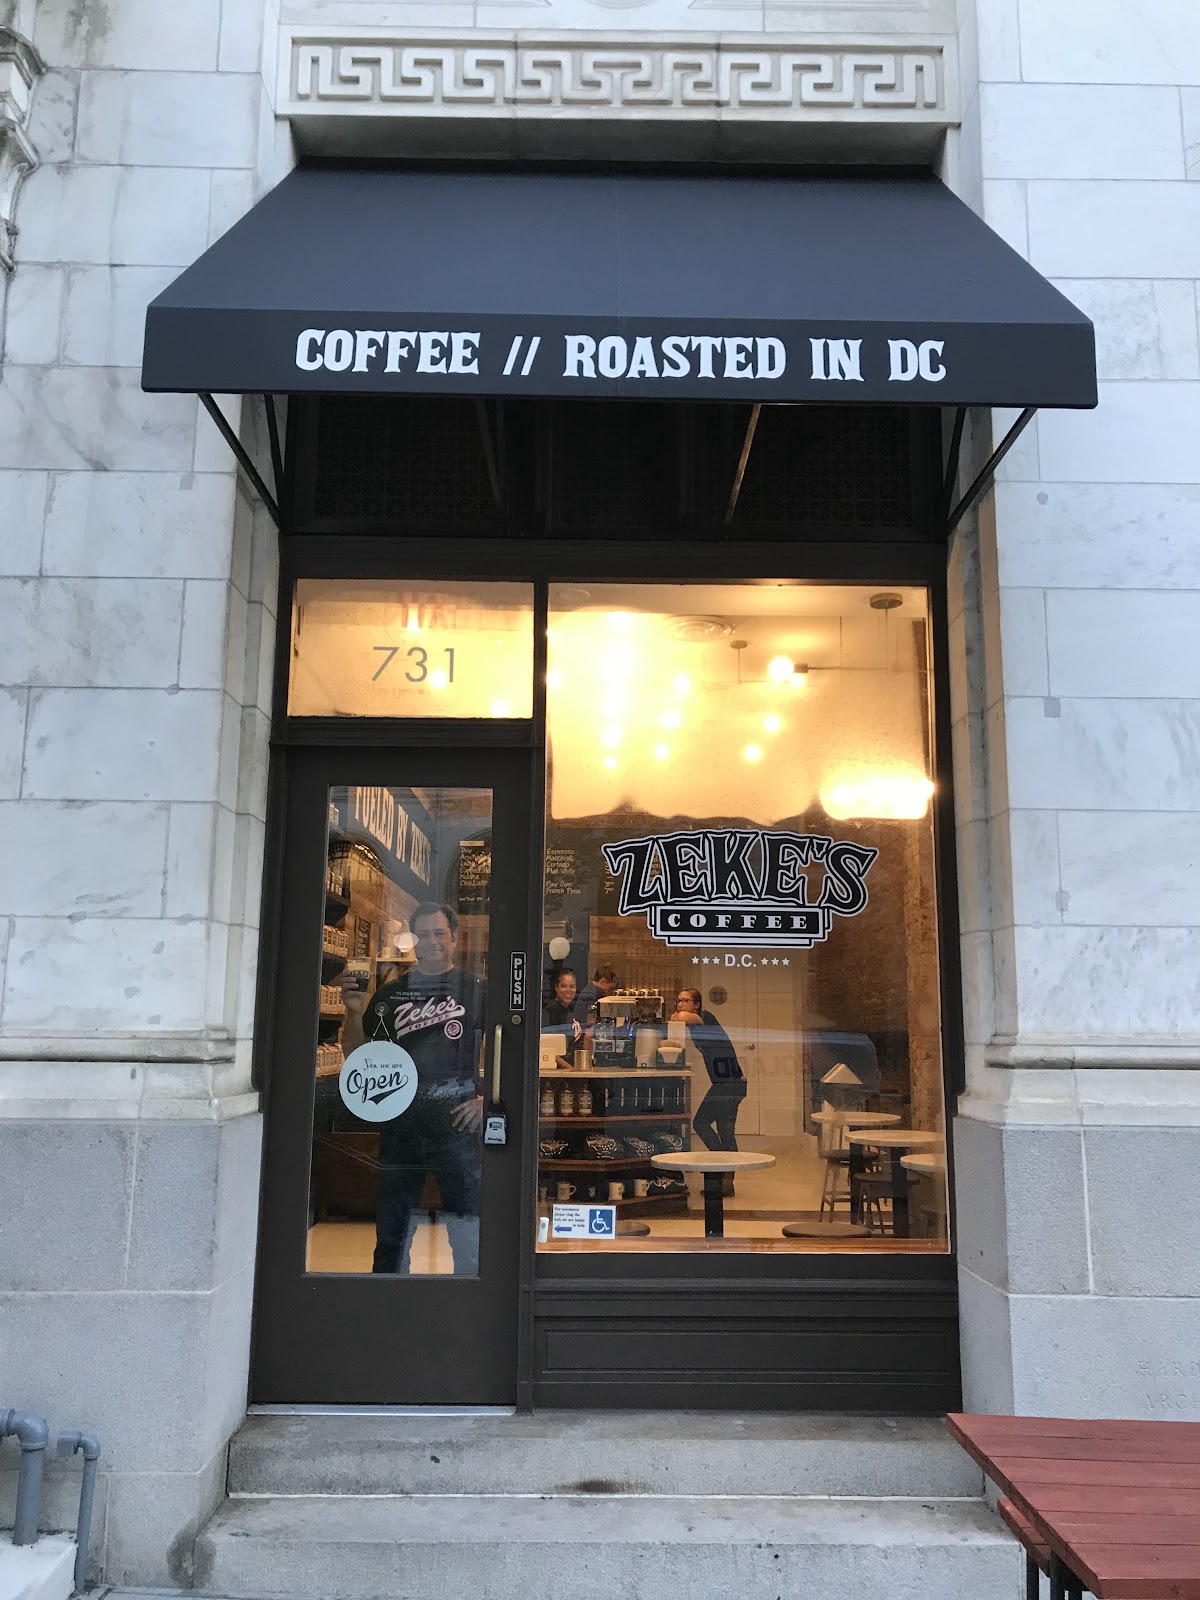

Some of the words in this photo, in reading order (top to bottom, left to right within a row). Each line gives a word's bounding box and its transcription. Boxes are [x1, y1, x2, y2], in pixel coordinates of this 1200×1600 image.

[295, 328, 481, 375] COFFEE
[562, 333, 786, 380] ROASTED
[808, 337, 865, 382] IN
[887, 338, 947, 382] DC
[371, 646, 455, 683] 731
[396, 803, 409, 863] BY
[601, 829, 879, 917] ZEKE'S
[667, 913, 808, 930] COFFEE
[724, 953, 757, 968] D.C.
[513, 957, 523, 1005] PUSH
[394, 995, 460, 1031] Zeke's
[346, 1068, 409, 1104] Open
